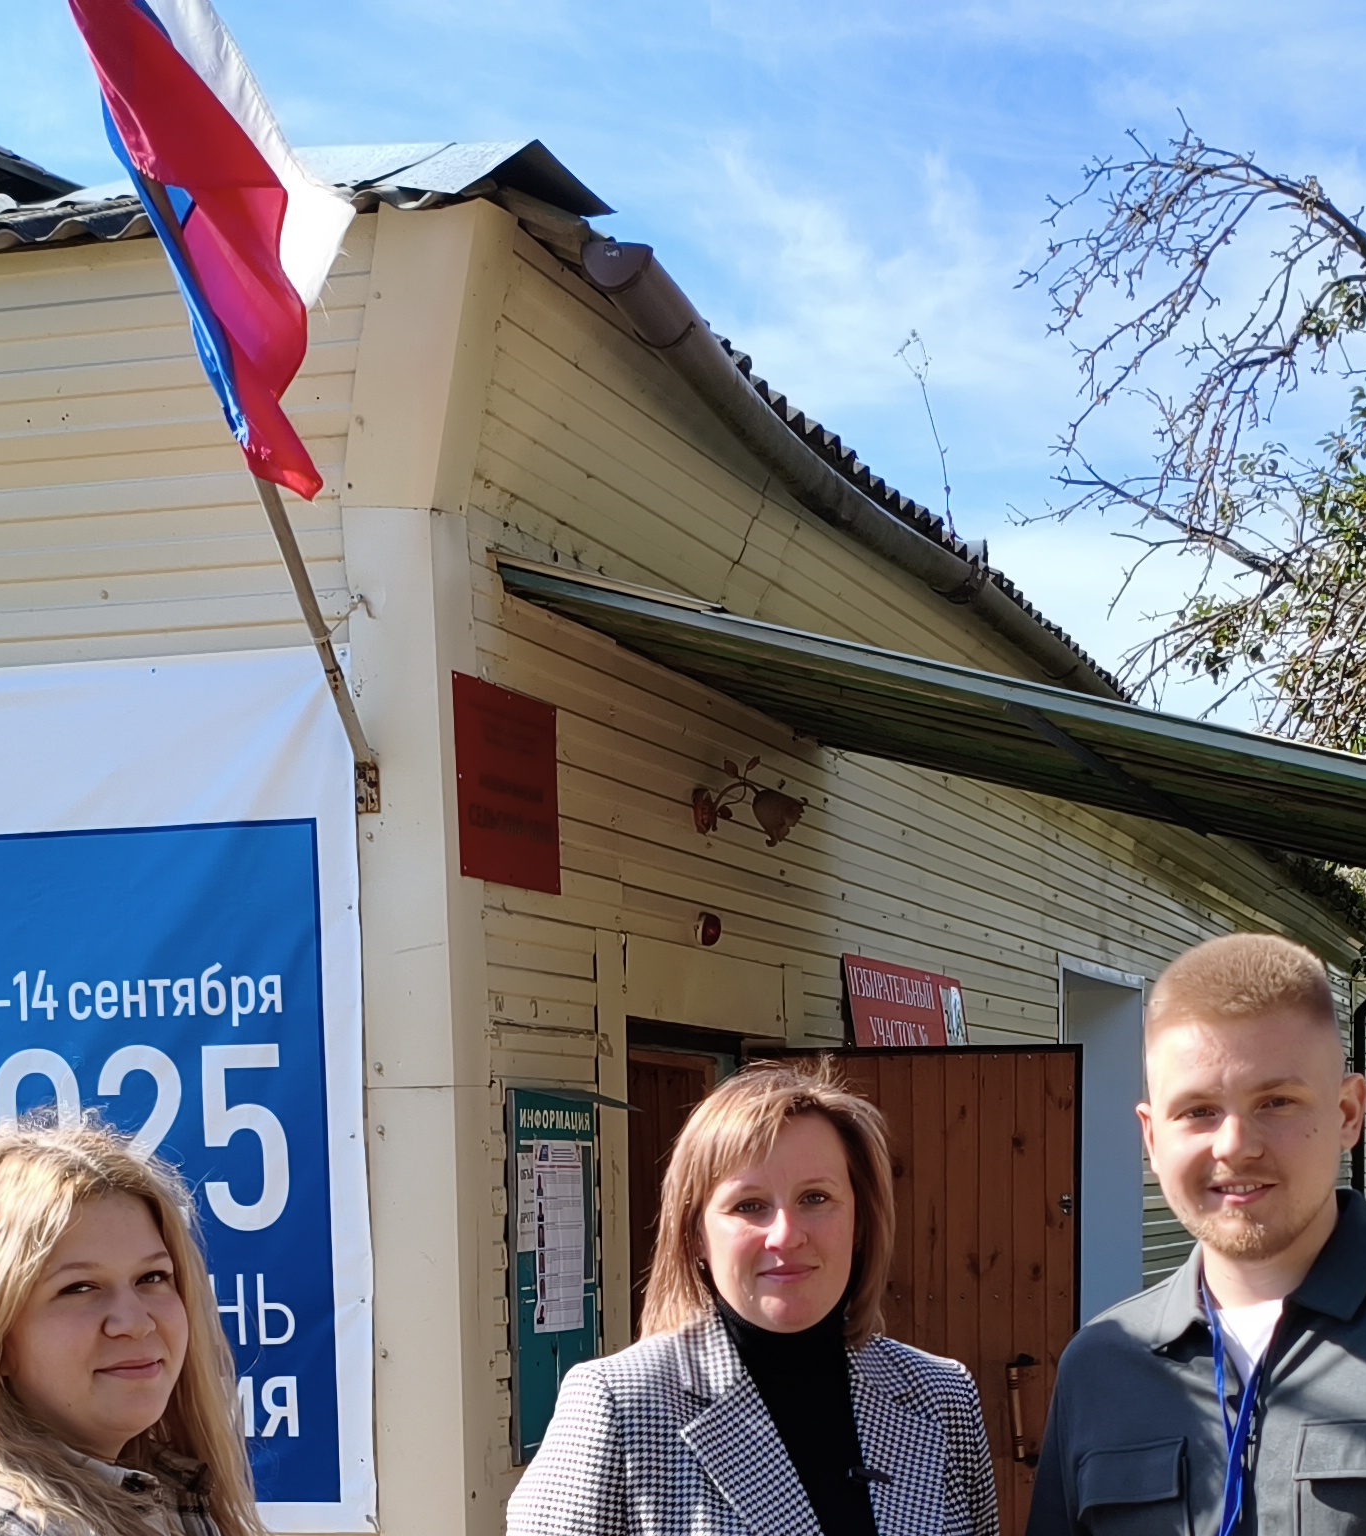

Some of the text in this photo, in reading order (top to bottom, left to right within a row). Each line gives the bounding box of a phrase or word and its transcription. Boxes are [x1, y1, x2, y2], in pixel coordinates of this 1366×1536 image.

[68, 962, 284, 1027] сентября
[848, 965, 936, 1010] ИЗБИРАТЕЛЬНЫЙ
[868, 1016, 916, 1047] УЧАСТОК
[519, 1107, 591, 1135] ИНФОРМАЦИЯ
